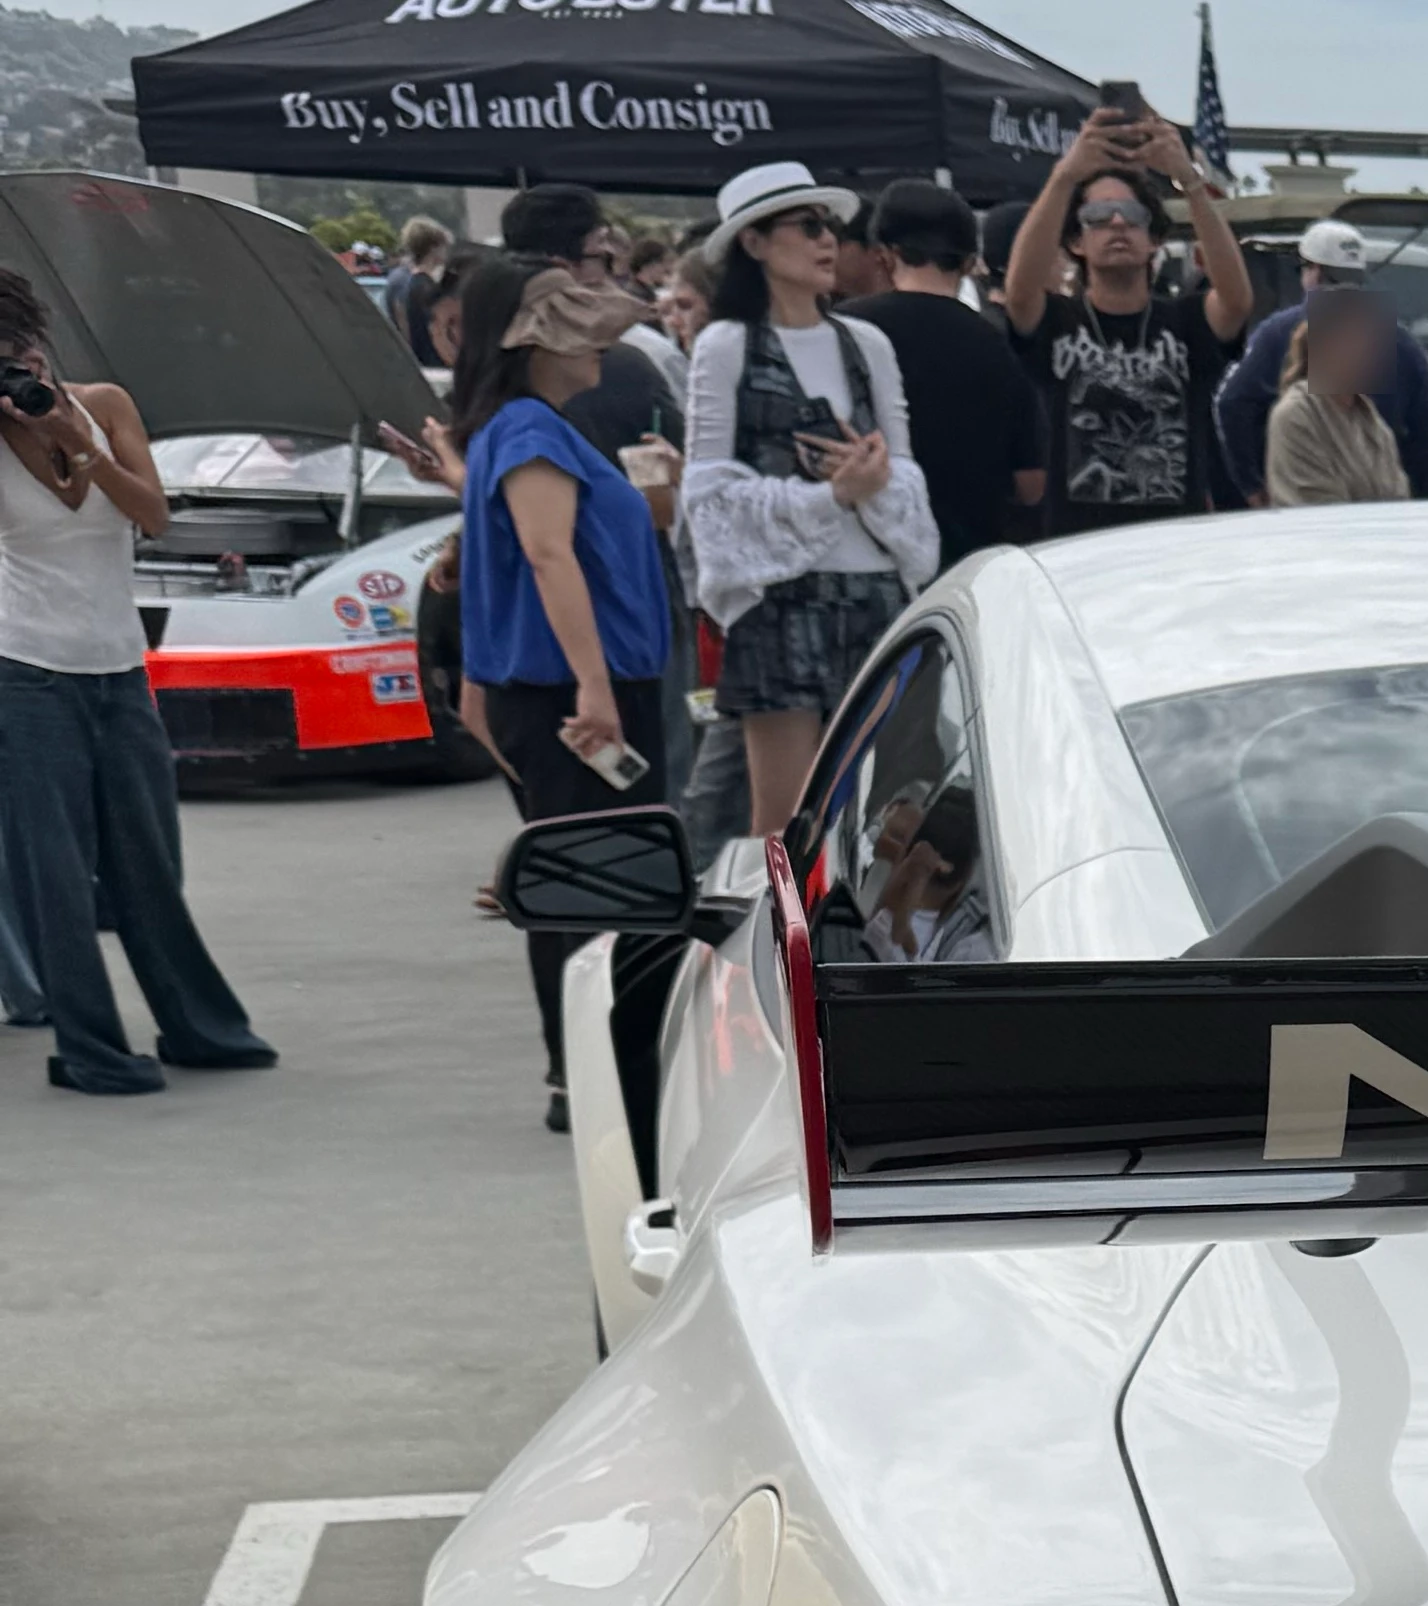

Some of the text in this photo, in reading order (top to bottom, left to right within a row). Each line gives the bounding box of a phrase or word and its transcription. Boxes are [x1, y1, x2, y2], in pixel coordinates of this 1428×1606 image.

[281, 81, 773, 146] Buy, Sell and Consign
